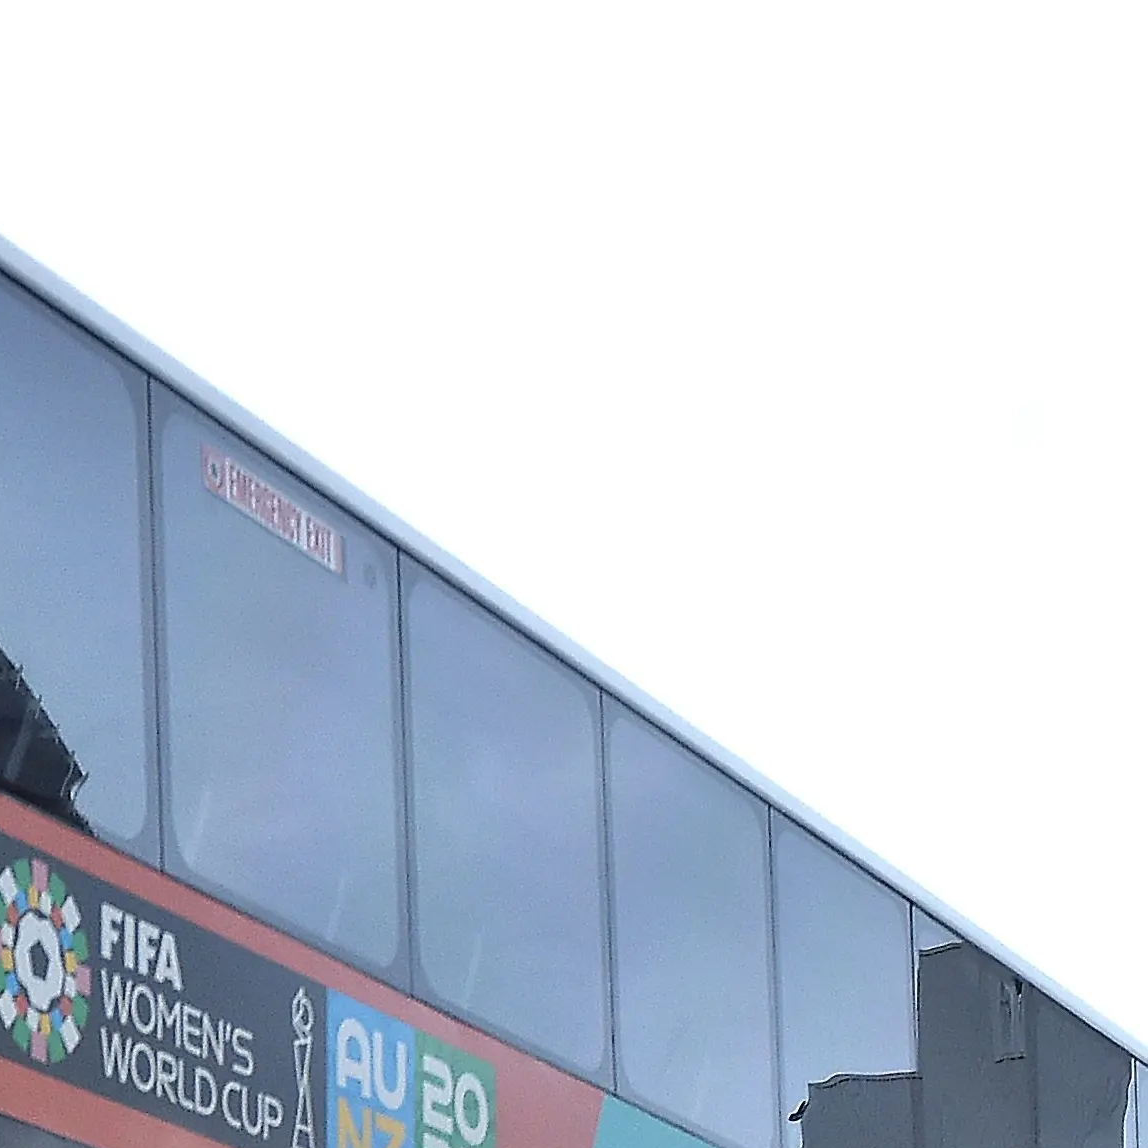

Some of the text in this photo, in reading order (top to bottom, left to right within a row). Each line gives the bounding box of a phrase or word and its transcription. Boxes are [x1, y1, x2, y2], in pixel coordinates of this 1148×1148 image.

[99, 902, 183, 991] FIFA
[100, 969, 254, 1077] WOMEN'S
[335, 1017, 408, 1110] AU
[100, 1027, 284, 1140] WORLD CUP
